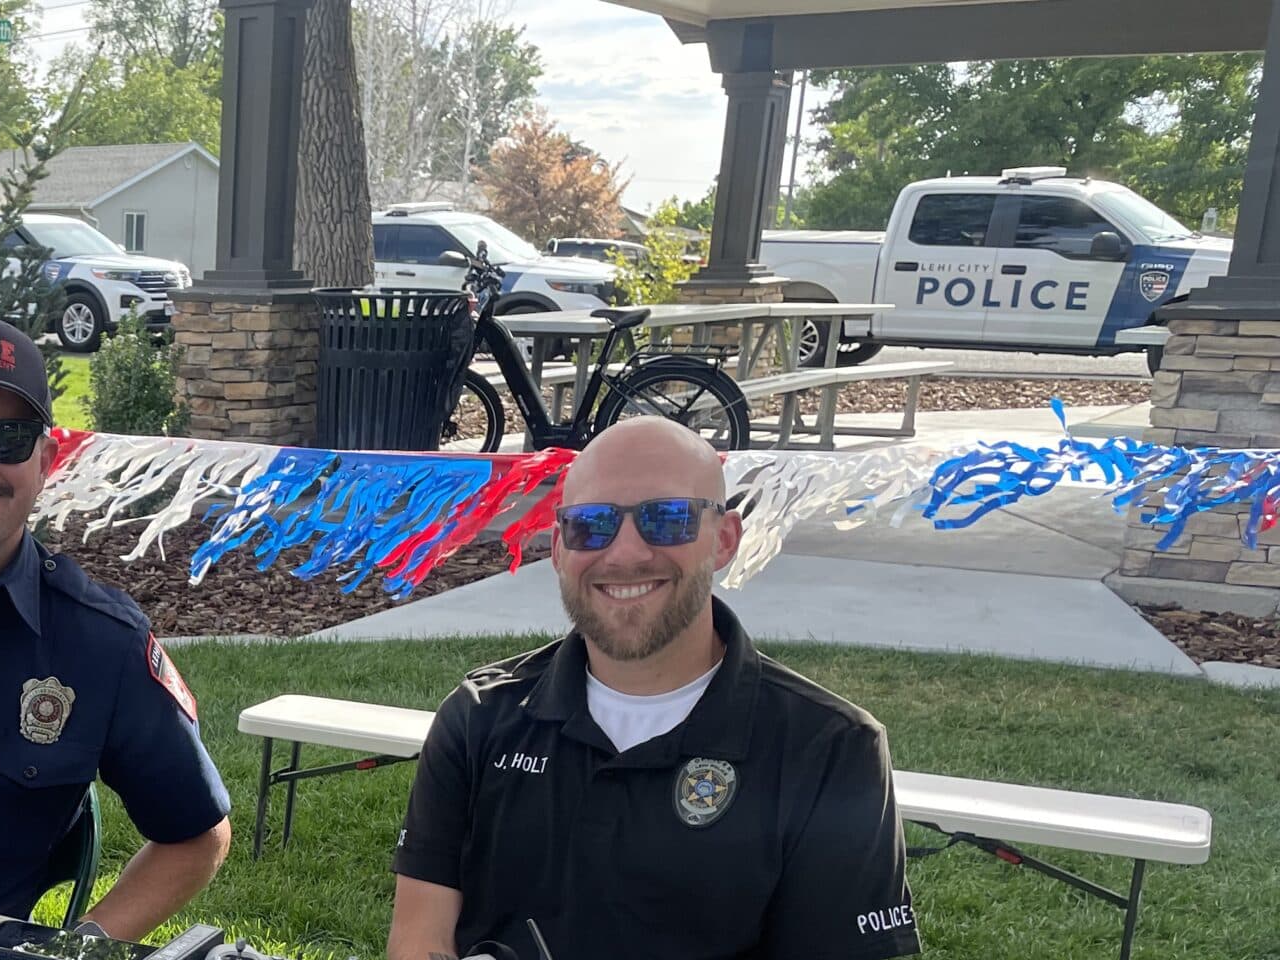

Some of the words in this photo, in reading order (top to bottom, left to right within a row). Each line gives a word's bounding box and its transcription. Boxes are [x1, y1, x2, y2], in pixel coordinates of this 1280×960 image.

[921, 263, 952, 272] LEHI
[958, 264, 990, 273] CITY
[916, 277, 1090, 310] POLICE
[494, 753, 507, 770] J.
[511, 752, 549, 774] HOLT
[857, 905, 913, 934] POLICE
